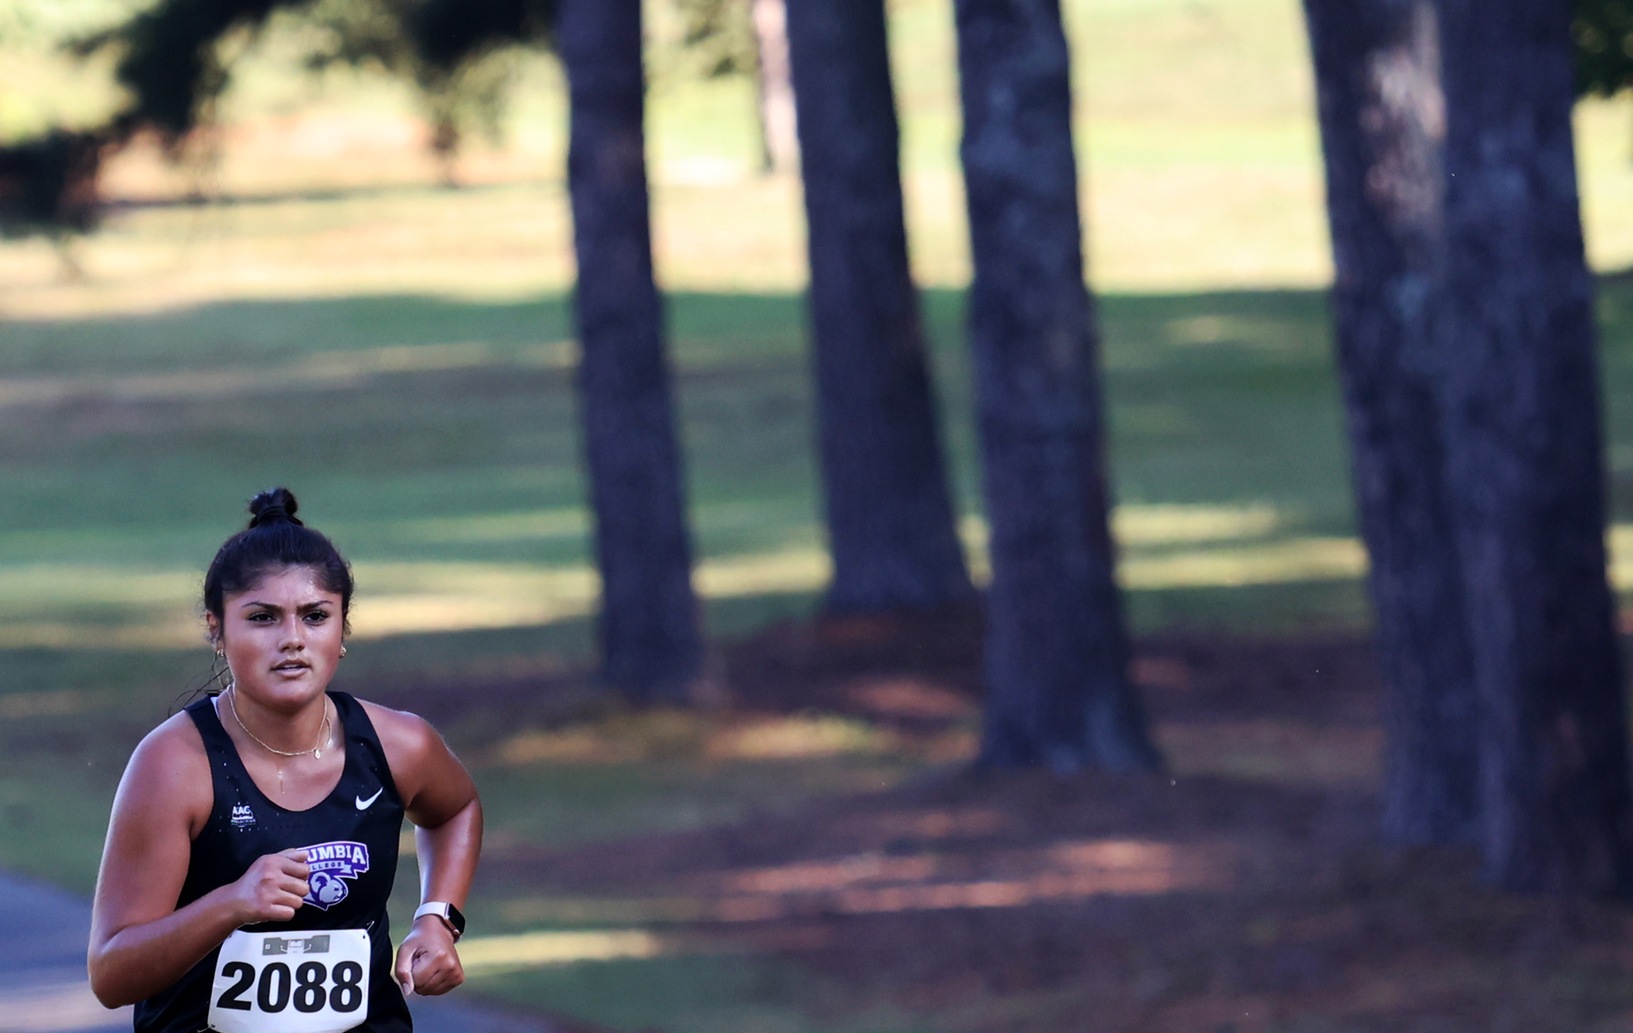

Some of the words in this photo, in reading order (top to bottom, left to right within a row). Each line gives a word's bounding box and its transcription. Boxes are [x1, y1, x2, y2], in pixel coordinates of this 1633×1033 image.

[307, 845, 366, 865] UMBIA
[311, 862, 342, 871] LLEGE
[216, 961, 363, 1013] 2088
